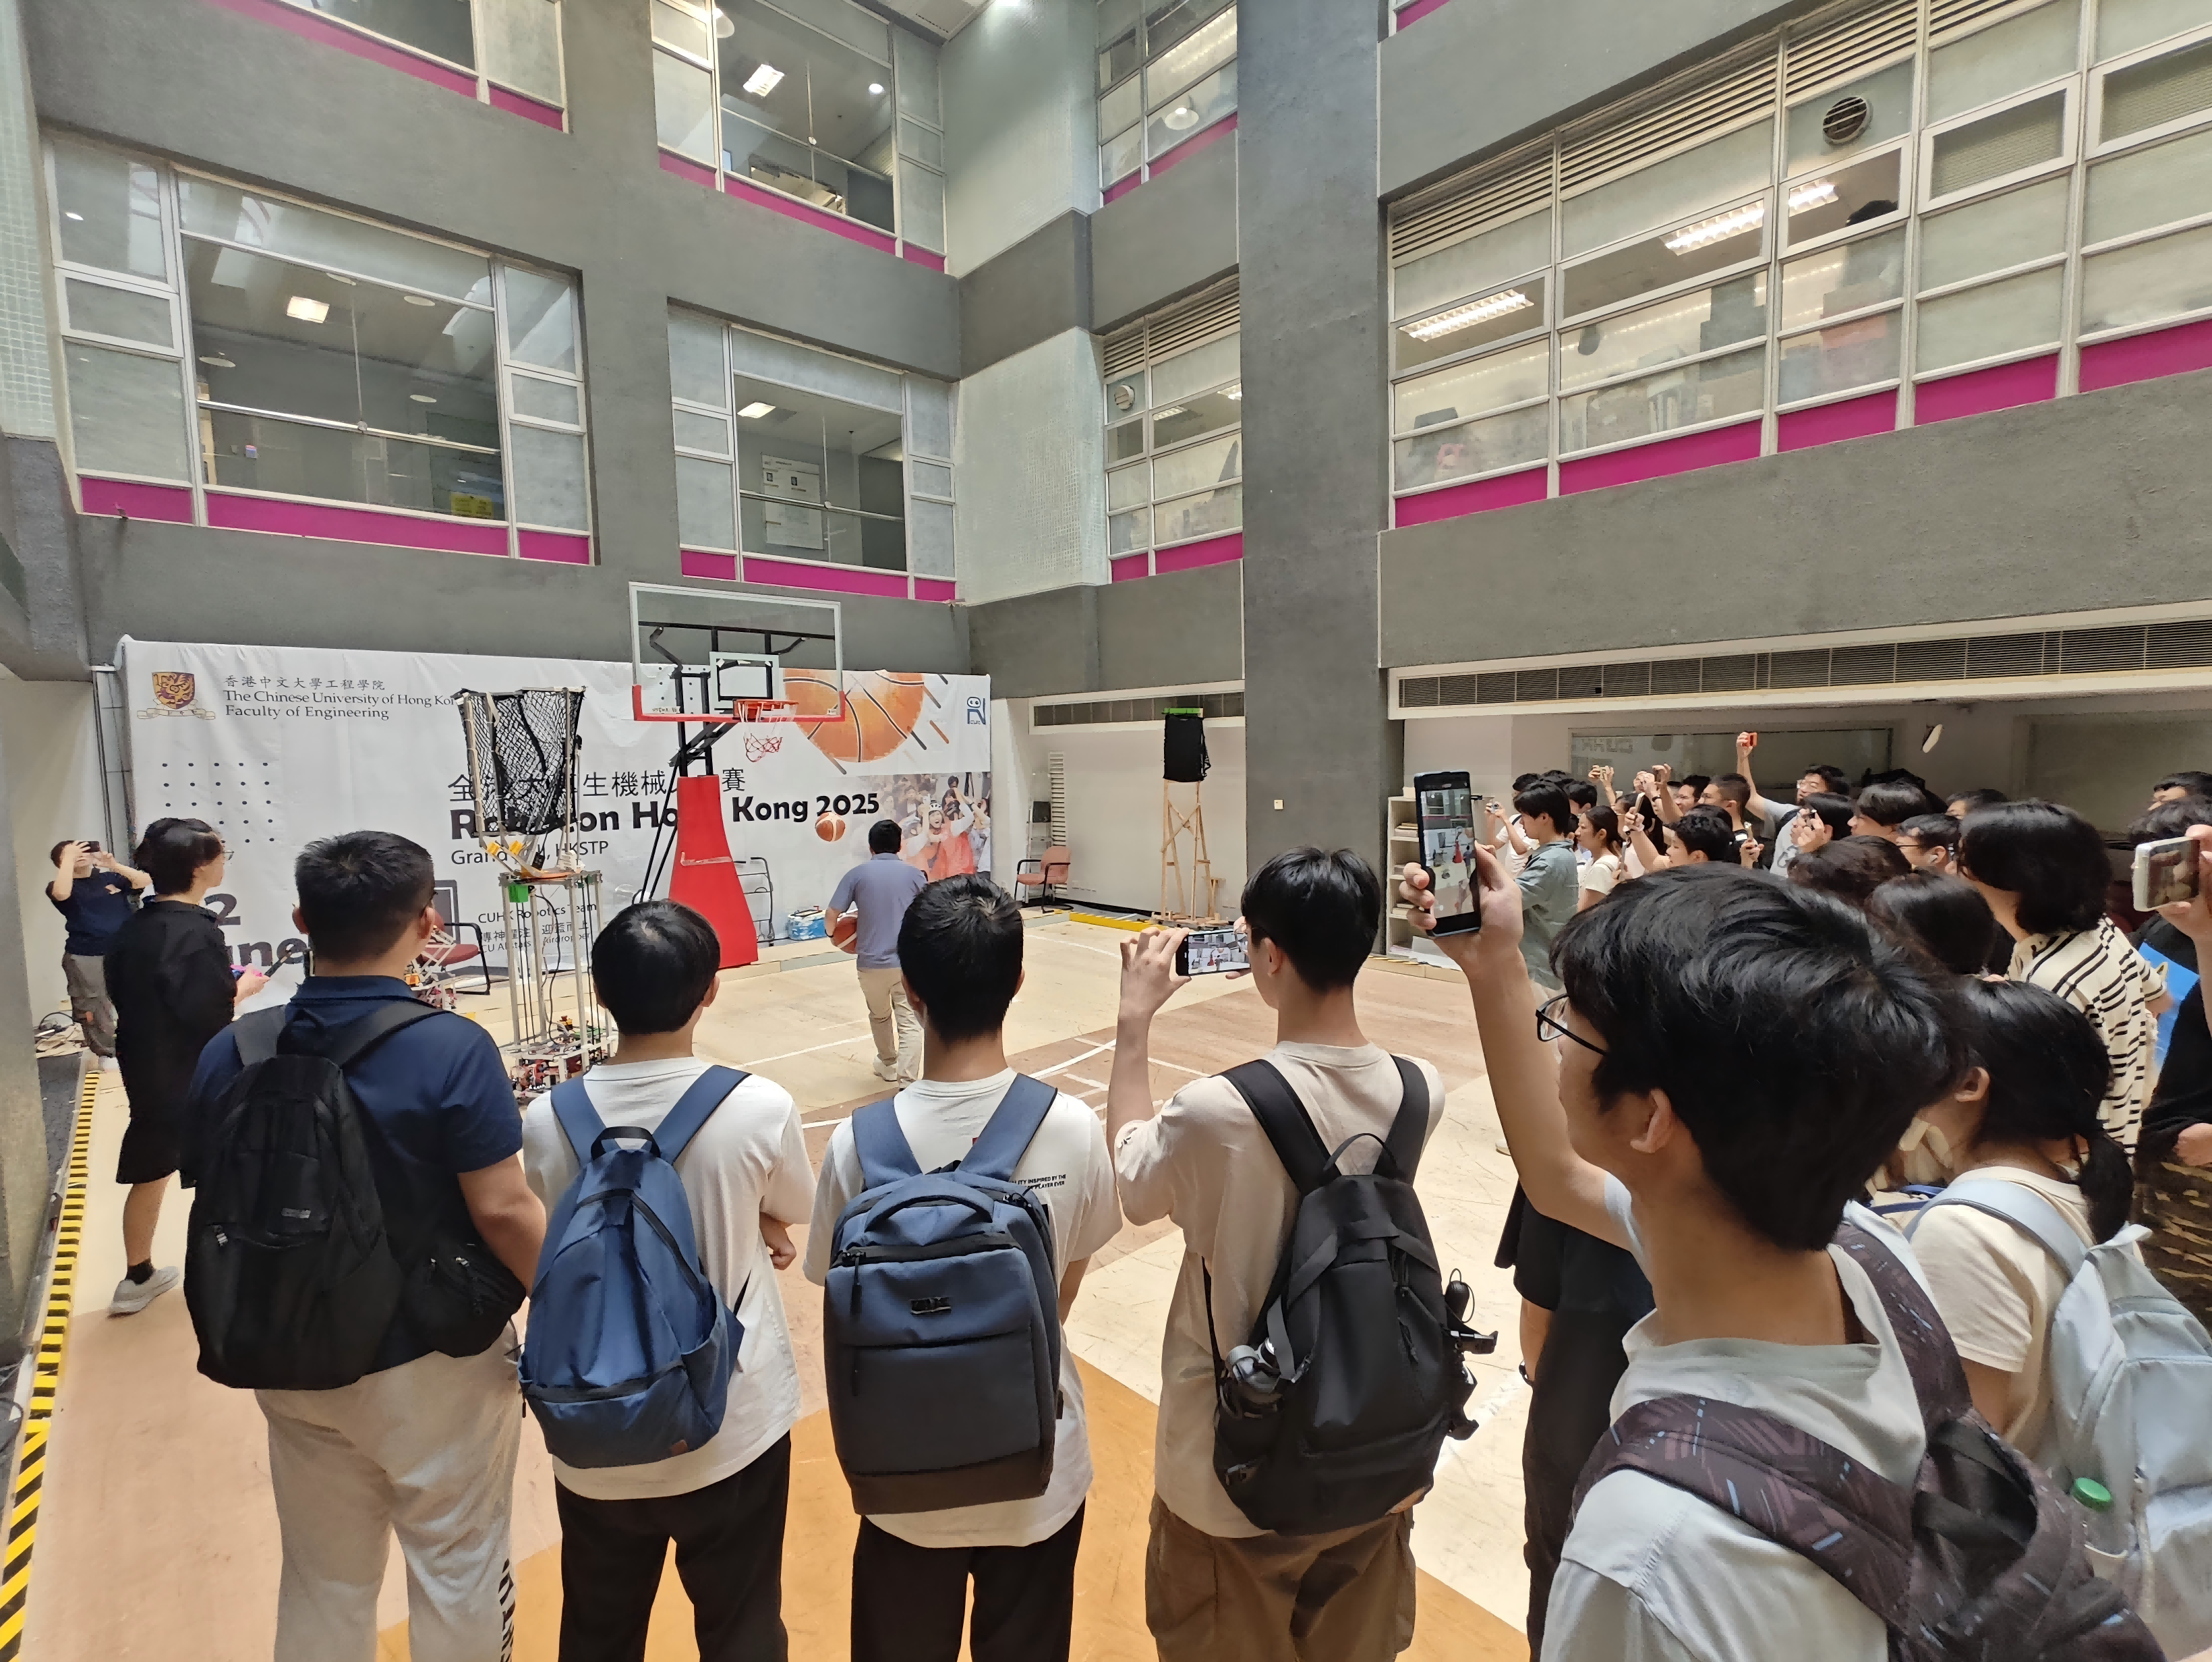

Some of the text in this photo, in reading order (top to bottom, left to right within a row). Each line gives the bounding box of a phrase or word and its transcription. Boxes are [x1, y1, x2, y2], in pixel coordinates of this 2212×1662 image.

[223, 675, 385, 691] 香港中文大學工程學院
[223, 690, 455, 708] The Chinese University of Hong Ko
[225, 705, 281, 720] Faculty
[286, 706, 300, 717] of
[305, 706, 389, 721] Engineering
[450, 793, 879, 840] Robon Ho Kong 2025
[556, 840, 609, 857] HKSTP
[478, 903, 597, 923] CUHK Rootcs eam
[225, 938, 308, 967] ne
